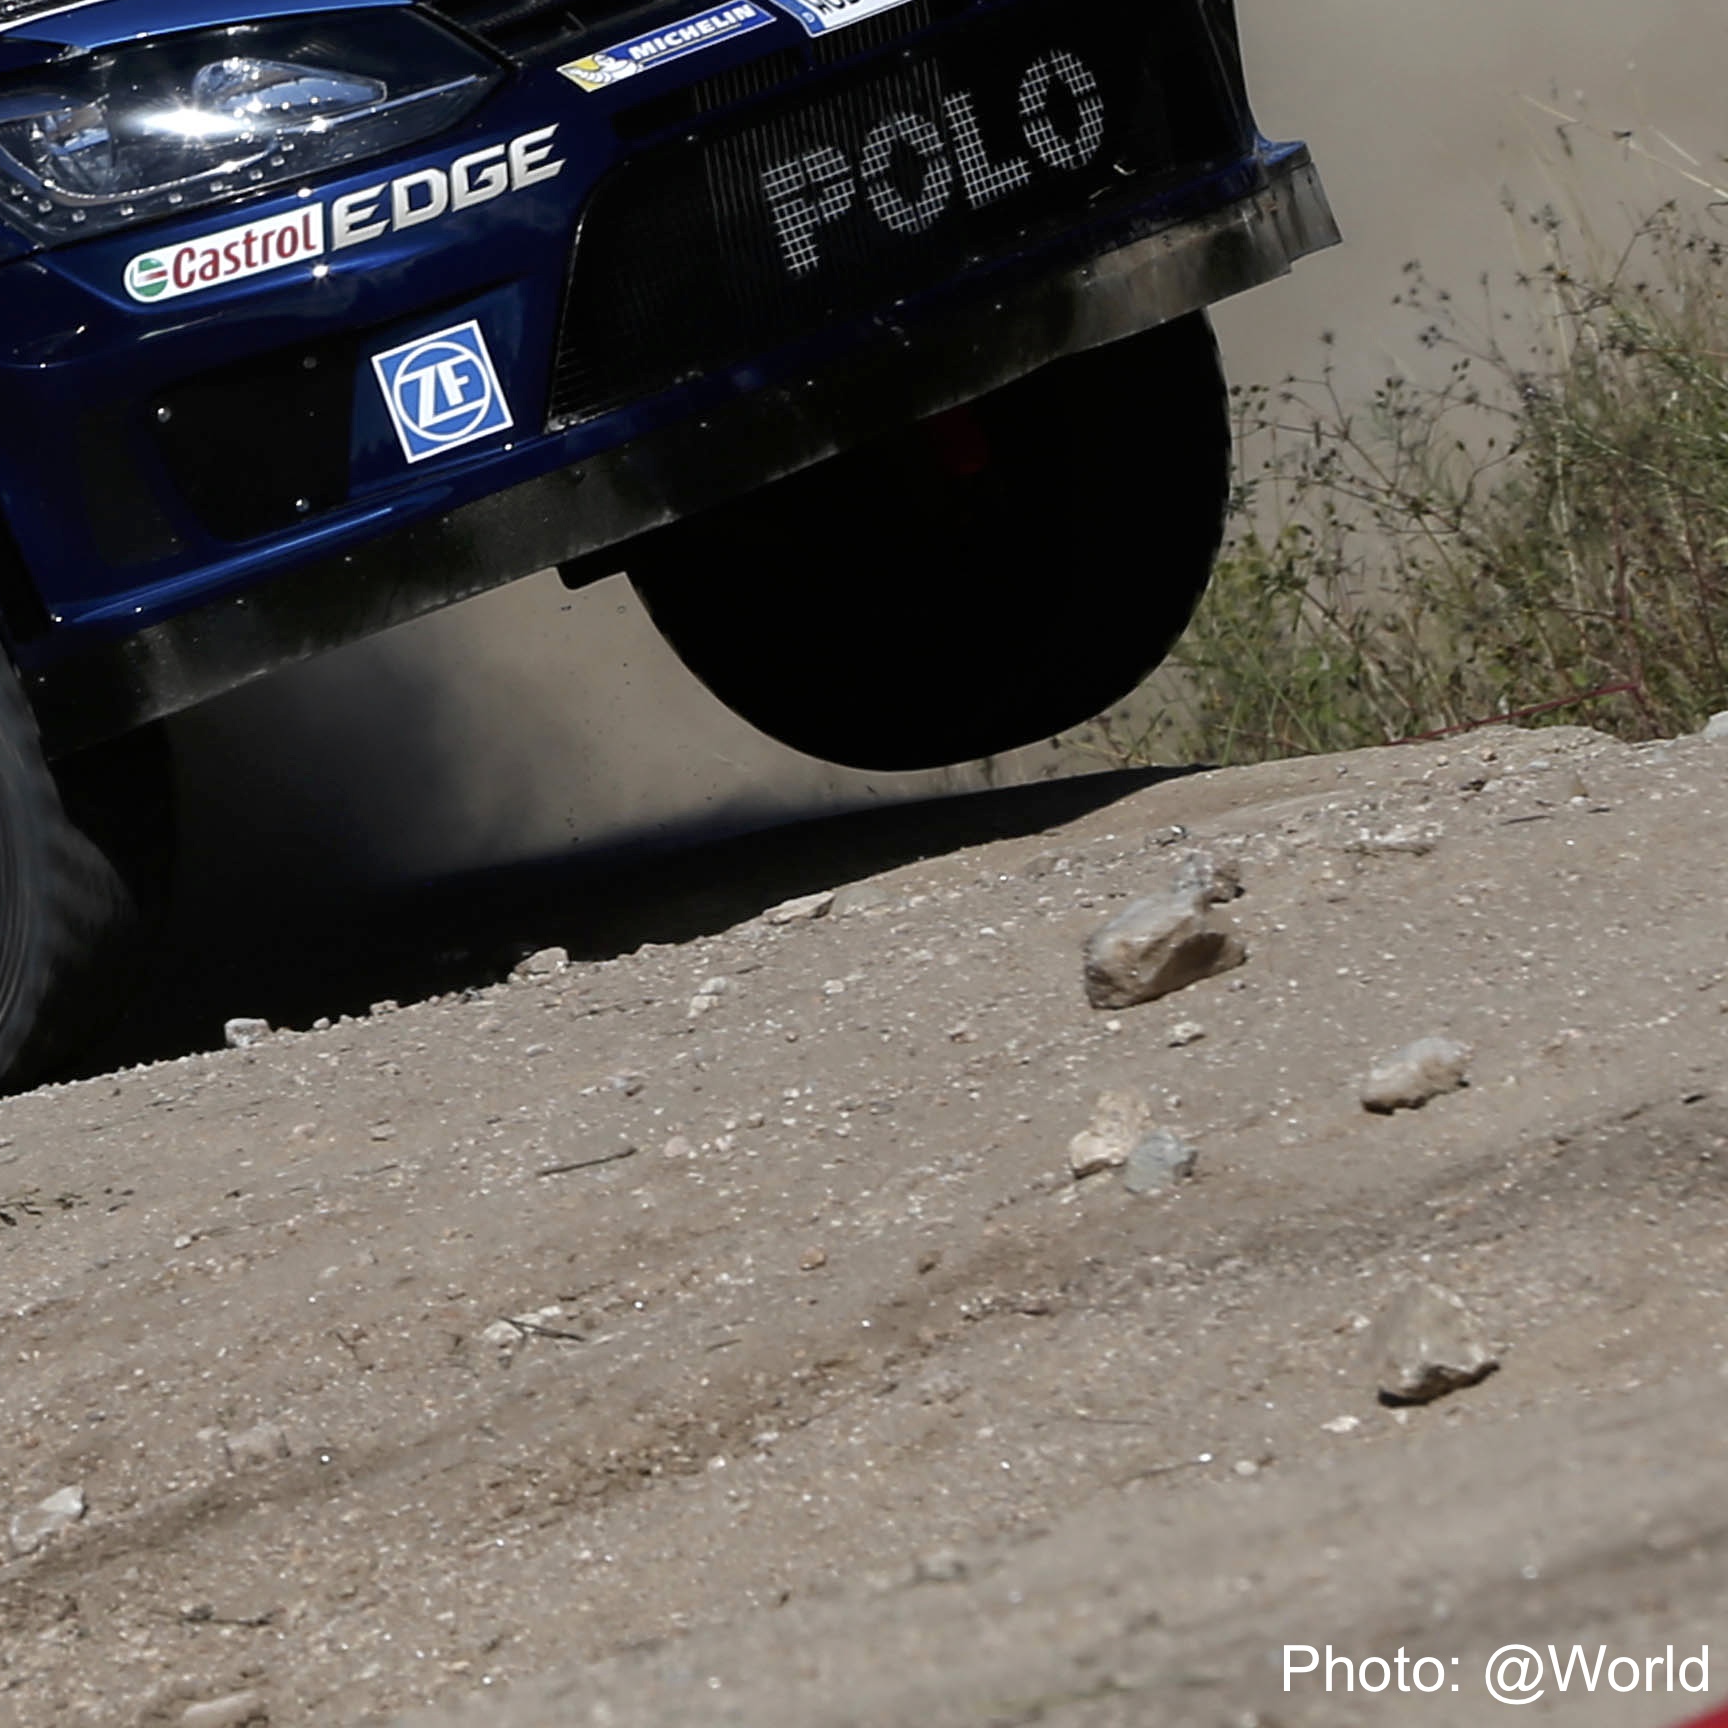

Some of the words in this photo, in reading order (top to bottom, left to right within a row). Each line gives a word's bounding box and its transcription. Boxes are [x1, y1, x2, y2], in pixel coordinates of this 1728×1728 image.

[628, 4, 757, 60] MICHELIN
[172, 214, 317, 289] Castrol
[331, 122, 566, 251] EDGE
[761, 49, 1104, 279] POLO
[398, 352, 487, 430] ZF
